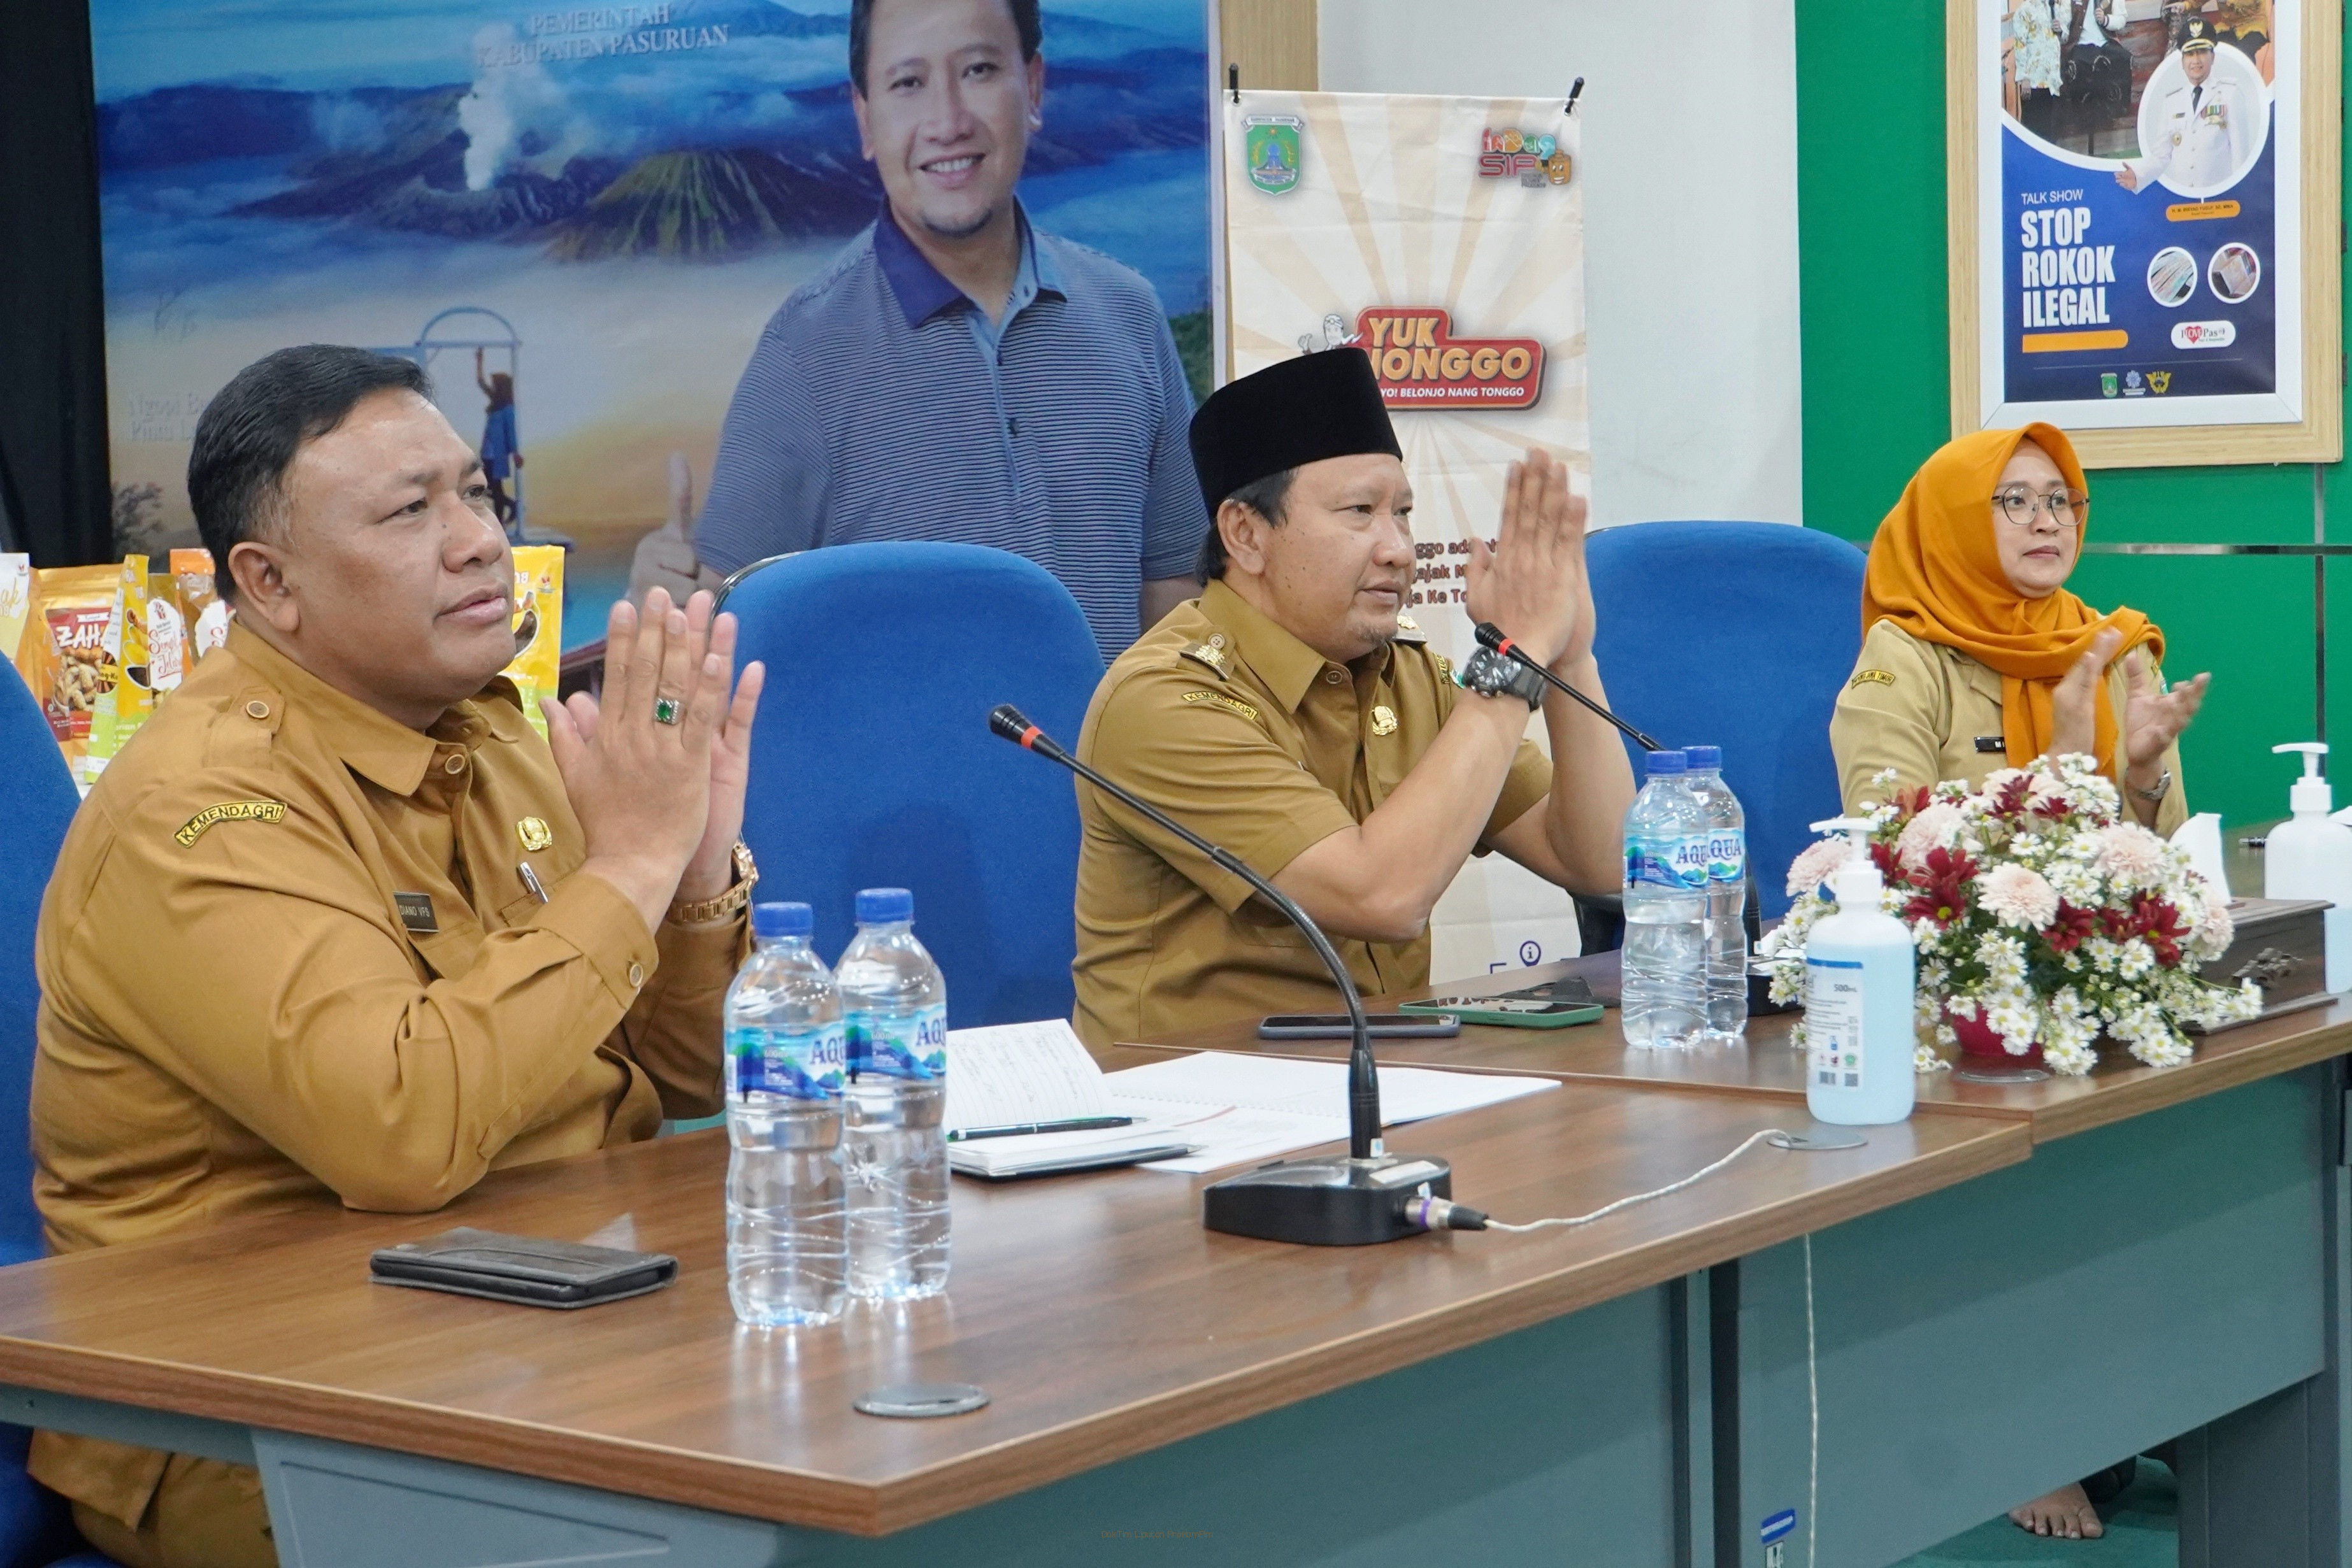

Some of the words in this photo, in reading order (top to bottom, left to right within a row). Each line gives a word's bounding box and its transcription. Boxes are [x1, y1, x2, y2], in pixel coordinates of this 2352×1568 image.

[531, 3, 671, 36] PEMERINTAH
[477, 34, 605, 68] KABUPATEN
[610, 24, 729, 57] PASURUAN
[2021, 192, 2047, 204] TALK
[2049, 189, 2083, 203] SHOW
[2021, 207, 2091, 248] STOP
[2022, 245, 2116, 288] ROKOK
[2023, 287, 2110, 328] ILEGAL
[1368, 317, 1439, 348] YUK
[1400, 387, 1445, 398] BELONJO
[1448, 387, 1478, 397] NANG
[1481, 387, 1524, 397] TONGGO
[1415, 541, 1444, 560] ggo
[1412, 564, 1450, 583] ajak
[1427, 589, 1447, 604] Ke
[56, 623, 105, 650] ZAH
[180, 804, 280, 841] KEMENDAGRI
